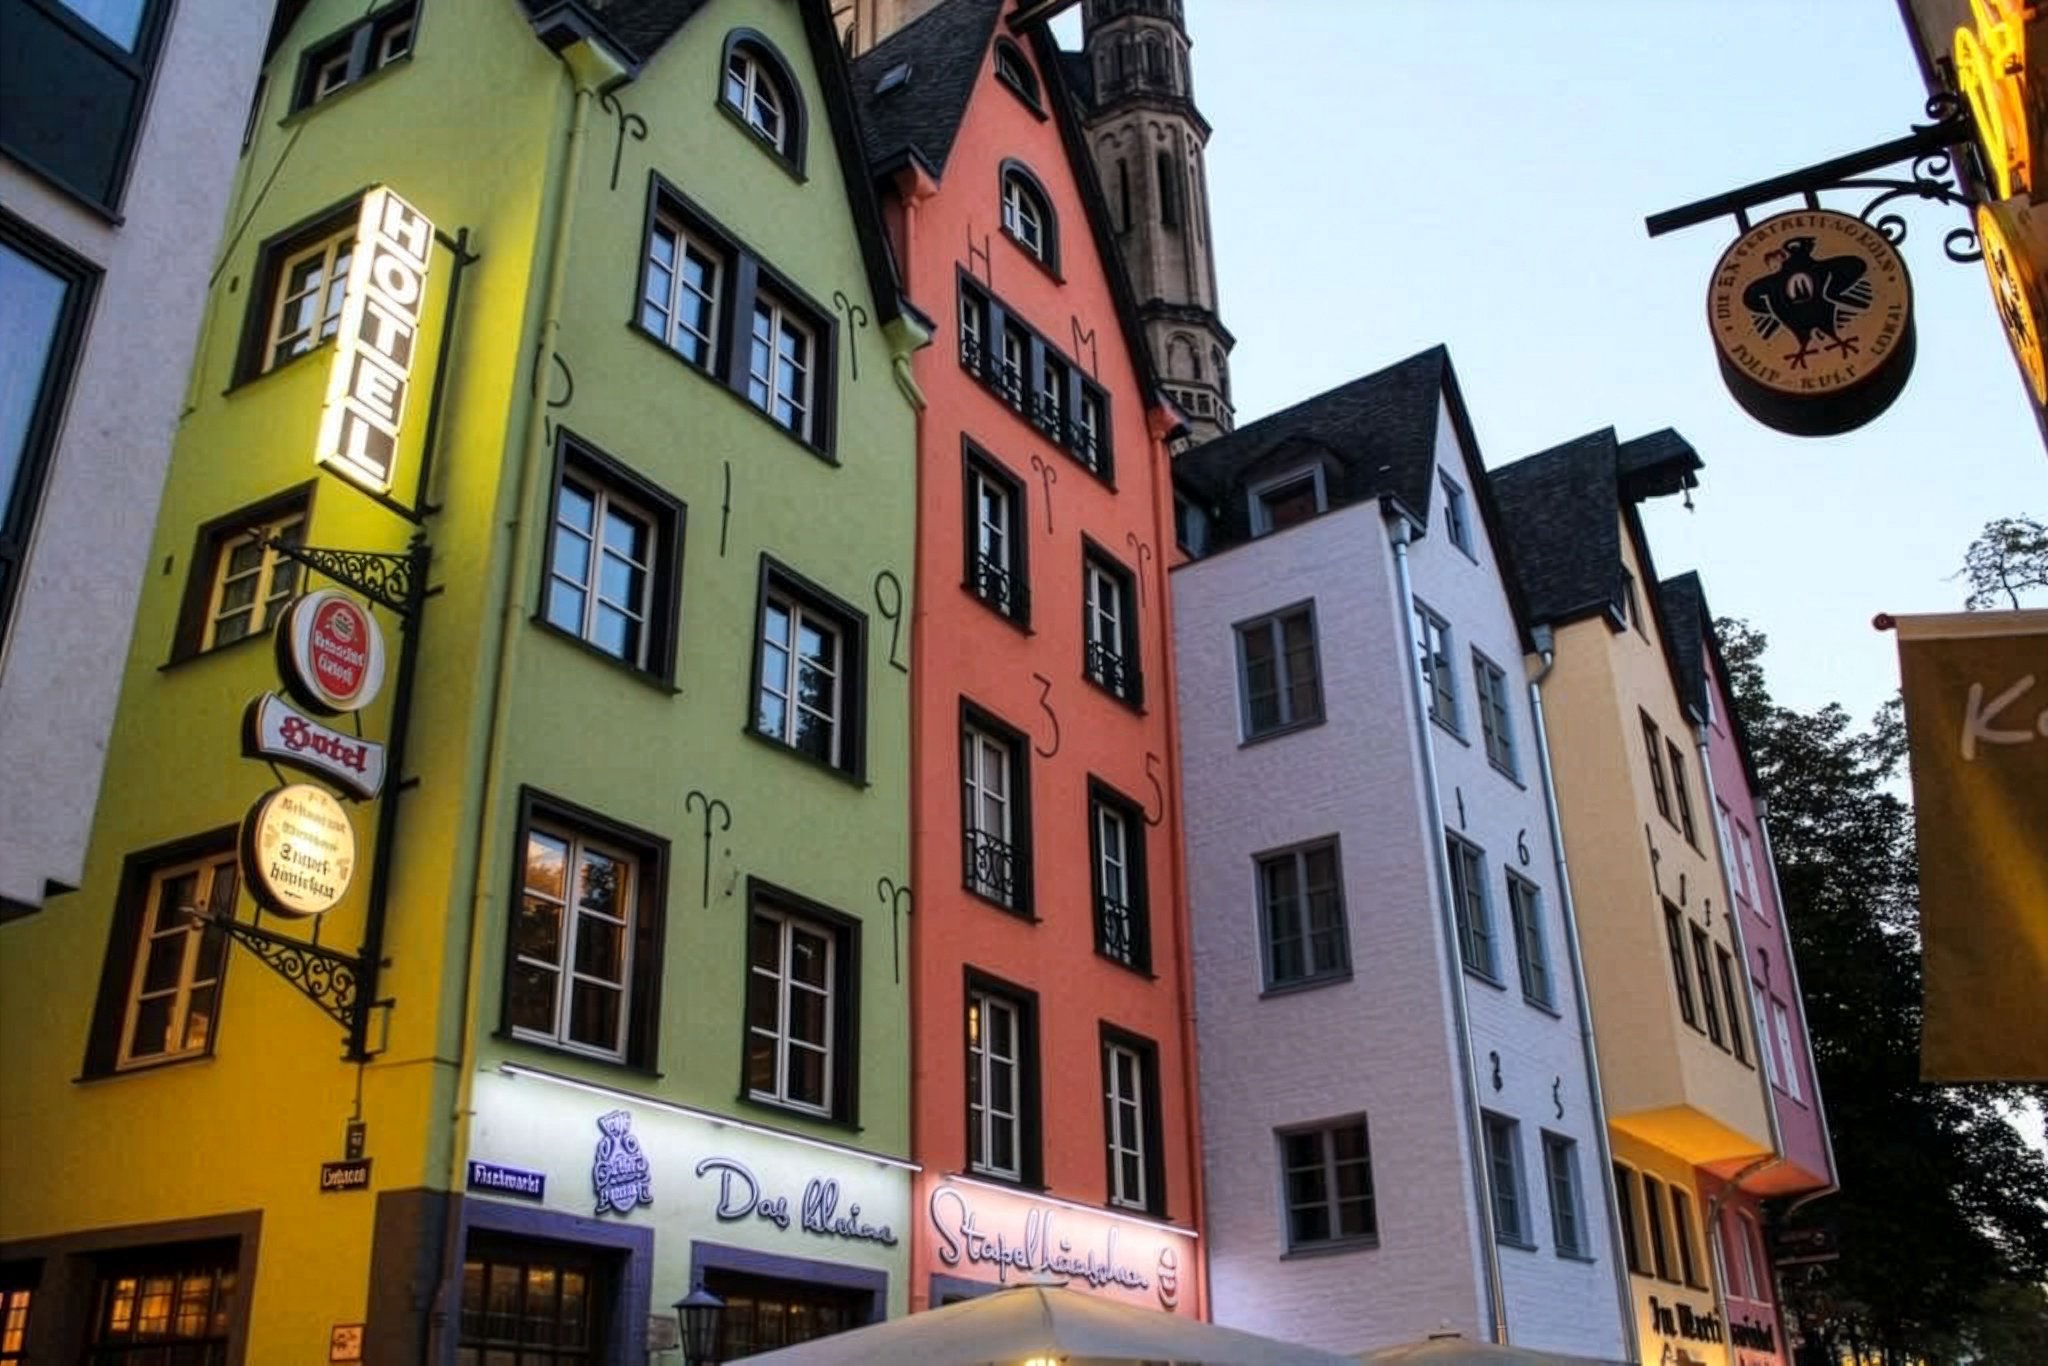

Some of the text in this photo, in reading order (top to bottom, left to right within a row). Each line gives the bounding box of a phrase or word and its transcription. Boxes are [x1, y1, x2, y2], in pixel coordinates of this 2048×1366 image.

[345, 193, 430, 481] HOTEL
[278, 715, 368, 774] Hotel
[1960, 673, 2048, 761] K
[473, 1163, 541, 1195] Fischmarkt
[695, 1156, 791, 1233] Das
[930, 1183, 1150, 1290] Stapelhäuschen
